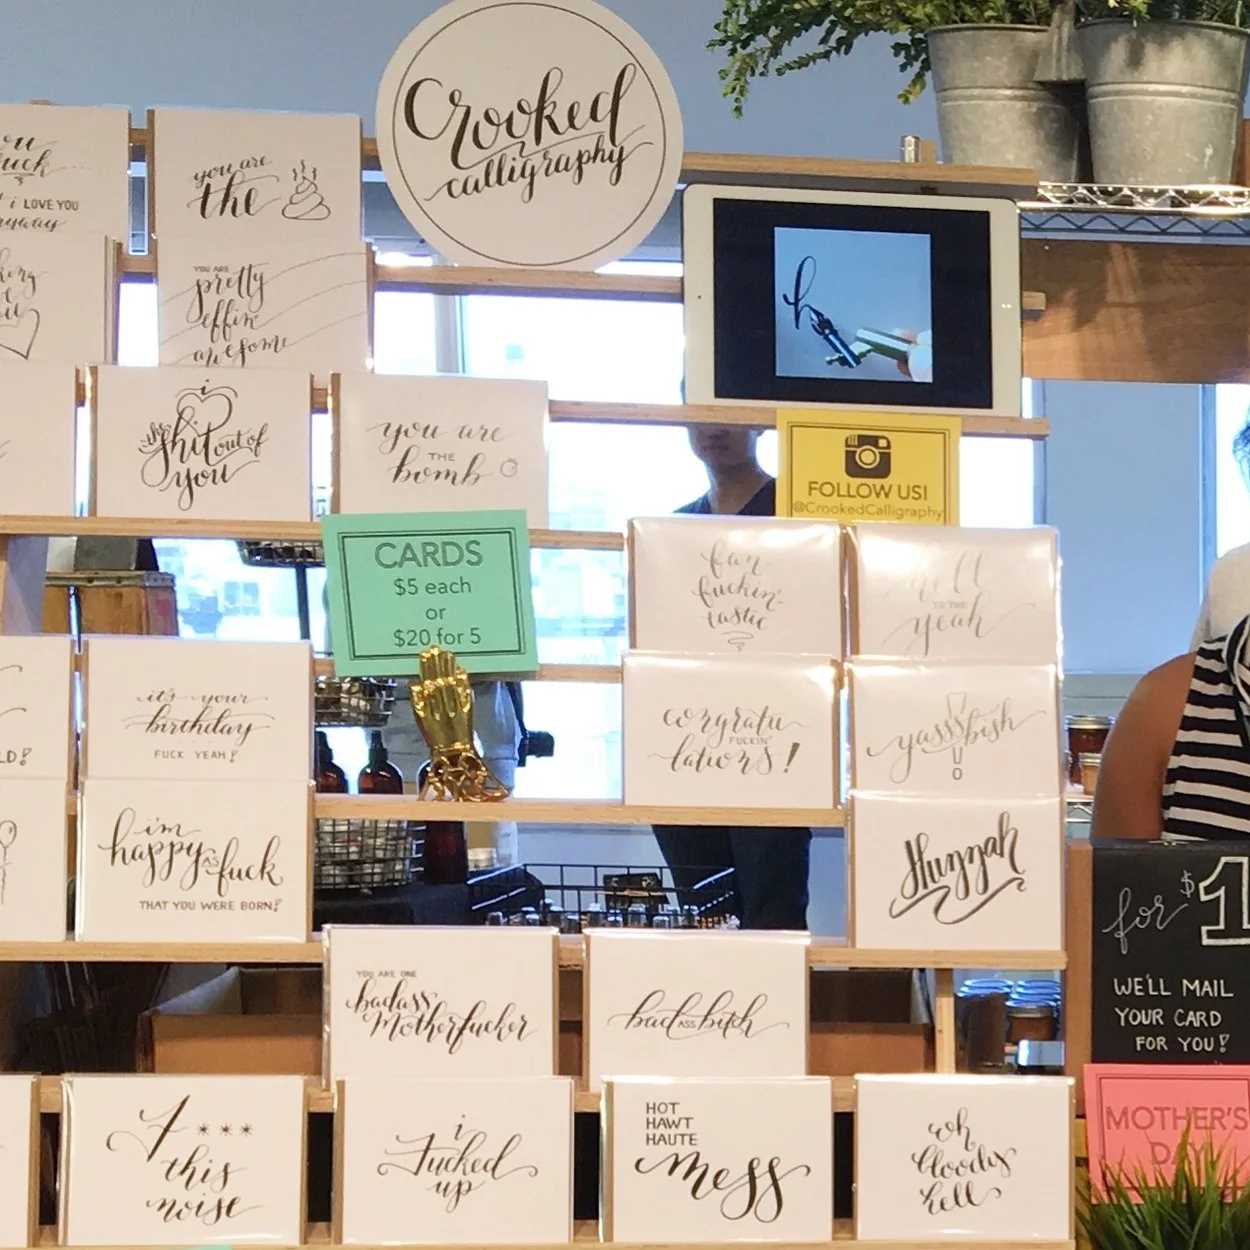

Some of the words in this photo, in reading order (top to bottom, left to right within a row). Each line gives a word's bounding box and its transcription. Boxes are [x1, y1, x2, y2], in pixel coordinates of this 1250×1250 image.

[405, 63, 637, 170] Crooked
[193, 163, 233, 190] you
[240, 155, 272, 171] are
[424, 124, 653, 202] calligraphy
[24, 198, 54, 210] LOVE
[58, 199, 79, 211] YOU
[188, 170, 280, 220] the
[193, 265, 210, 273] YOU
[213, 265, 230, 273] ARE
[186, 263, 266, 323] pretty
[364, 420, 451, 454] you
[453, 420, 508, 443] are
[389, 444, 495, 487] bomb
[428, 452, 456, 461] THE
[160, 464, 260, 511] you
[807, 481, 893, 500] FOLLOW
[897, 484, 928, 501] US!
[792, 501, 944, 520] @CrookedCalligraphy
[374, 540, 484, 569] CARDS
[393, 576, 420, 598] $5
[424, 576, 472, 597] each
[425, 604, 447, 622] or
[393, 628, 431, 649] $20
[436, 627, 466, 647] for
[469, 628, 482, 646] 5
[190, 692, 268, 711] your
[123, 707, 274, 748] birthday
[154, 749, 184, 760] FUCK
[99, 808, 208, 887] happy
[213, 834, 284, 897] fuck
[140, 901, 168, 912] THAT
[173, 901, 196, 912] YOU
[200, 901, 236, 912] WERE
[1103, 888, 1187, 955] for
[357, 970, 375, 979] YOU
[378, 970, 396, 978] ARE
[400, 970, 416, 978] ONE
[1113, 975, 1171, 996] WE'LL
[1182, 979, 1234, 998] MAIL
[346, 978, 437, 1015] badass
[363, 1000, 538, 1054] Motherfucker
[612, 990, 682, 1039] bad
[696, 990, 773, 1039] bitch
[1115, 1007, 1164, 1027] YOUR
[1174, 1009, 1222, 1028] CARD
[1136, 1035, 1168, 1052] FOR
[1178, 1034, 1230, 1053] YOU!
[646, 1102, 680, 1115] HOT
[646, 1117, 694, 1130] HAWT
[1105, 1106, 1249, 1131] MOTHER'S
[646, 1133, 698, 1146] HAUTE
[928, 1107, 976, 1152] oh
[161, 1144, 248, 1192] this
[431, 1178, 481, 1214] up
[635, 1151, 810, 1223] mess
[919, 1181, 1002, 1215] hell
[146, 1193, 262, 1225] noise
